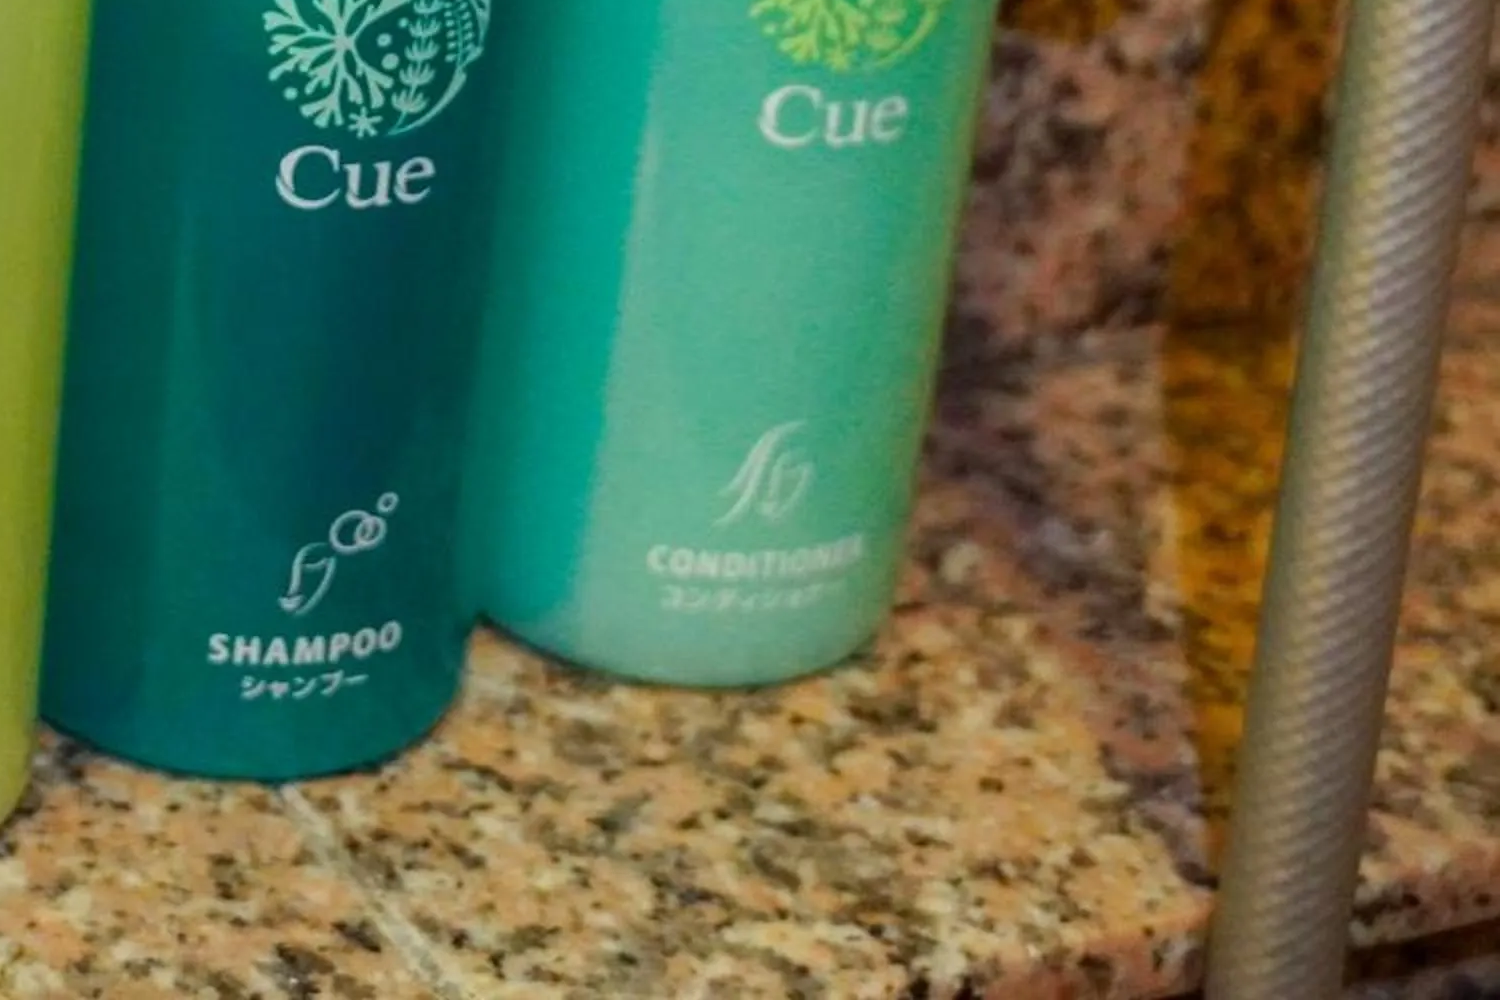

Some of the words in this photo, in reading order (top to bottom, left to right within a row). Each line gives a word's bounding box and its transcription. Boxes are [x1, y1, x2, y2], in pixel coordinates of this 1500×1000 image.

[757, 83, 909, 150] Cue
[275, 144, 436, 209] Cue
[207, 619, 403, 665] SHAMPOO
